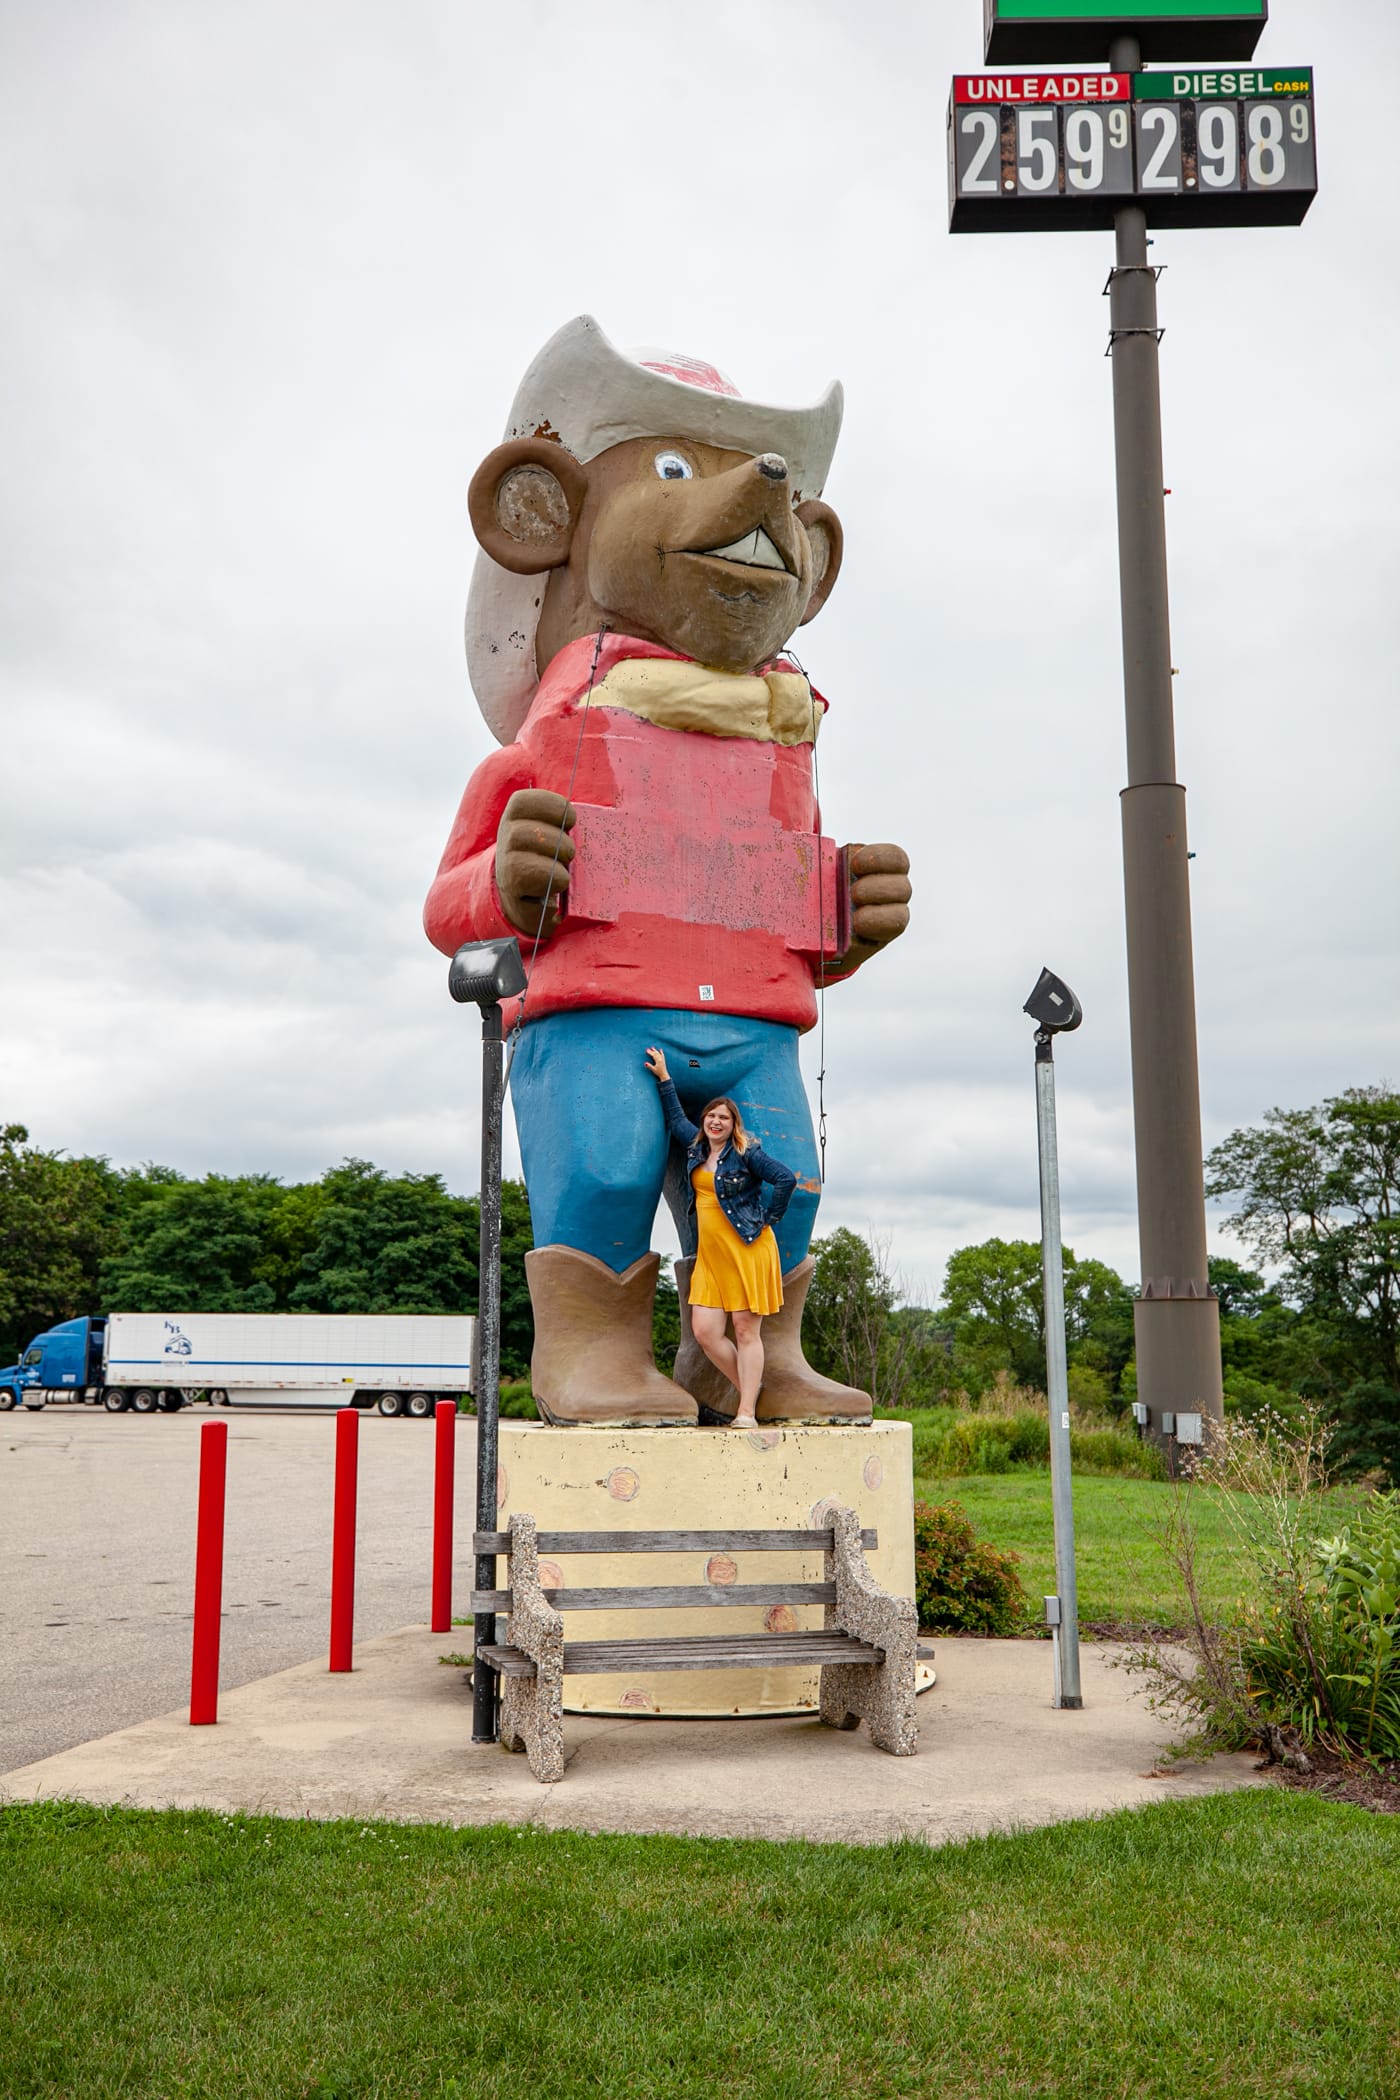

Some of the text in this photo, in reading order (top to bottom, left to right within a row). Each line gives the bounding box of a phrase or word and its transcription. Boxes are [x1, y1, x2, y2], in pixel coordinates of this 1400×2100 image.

[968, 77, 1118, 99] UNLEADED
[1173, 73, 1309, 95] DIESEL CASH
